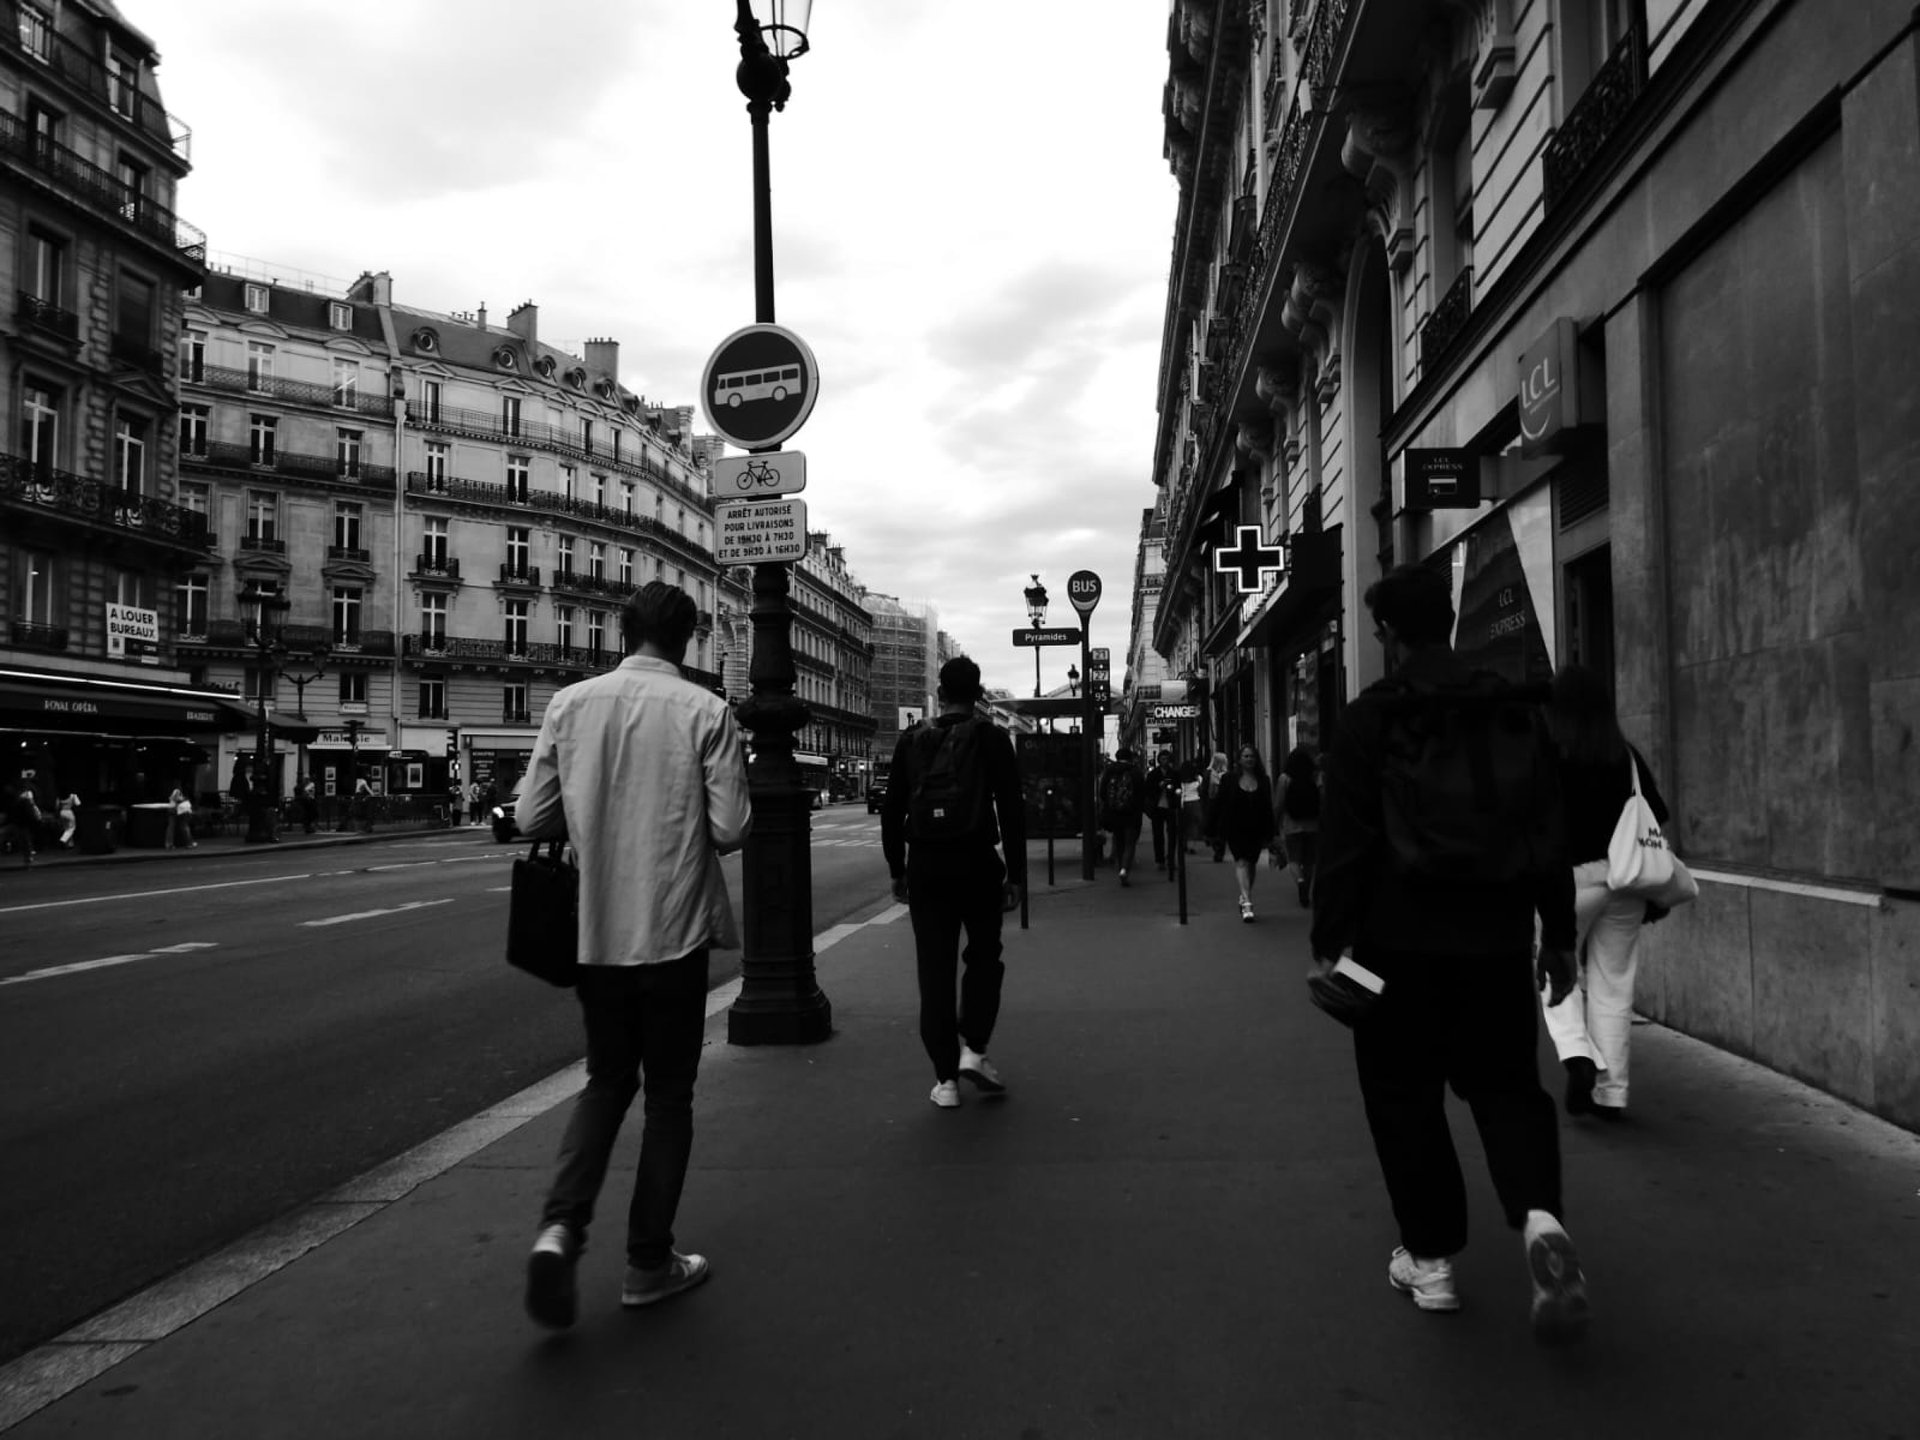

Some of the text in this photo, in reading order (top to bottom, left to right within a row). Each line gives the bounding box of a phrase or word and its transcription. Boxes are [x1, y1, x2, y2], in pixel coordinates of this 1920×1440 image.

[1522, 357, 1555, 409] LCL
[1423, 463, 1463, 471] EXPRESS
[728, 504, 791, 519] ARRÊT AUTORISÉ
[725, 518, 794, 532] POUR LIVRAISONS
[725, 536, 734, 545] DE
[773, 531, 794, 541] 7H30
[719, 549, 728, 558] ET
[730, 548, 740, 557] DE
[743, 546, 764, 557] 9H30
[775, 544, 800, 554] 16H30
[1072, 580, 1097, 593] BUS
[111, 608, 154, 625] A LOUER
[111, 622, 155, 639] BUREAUX
[1490, 610, 1526, 639] EXPRESS
[1025, 633, 1067, 642] Pyramides
[1094, 671, 1107, 680] 27
[1094, 692, 1108, 701] 95
[44, 700, 69, 711] ROYAL
[1154, 705, 1196, 718] CHANGE
